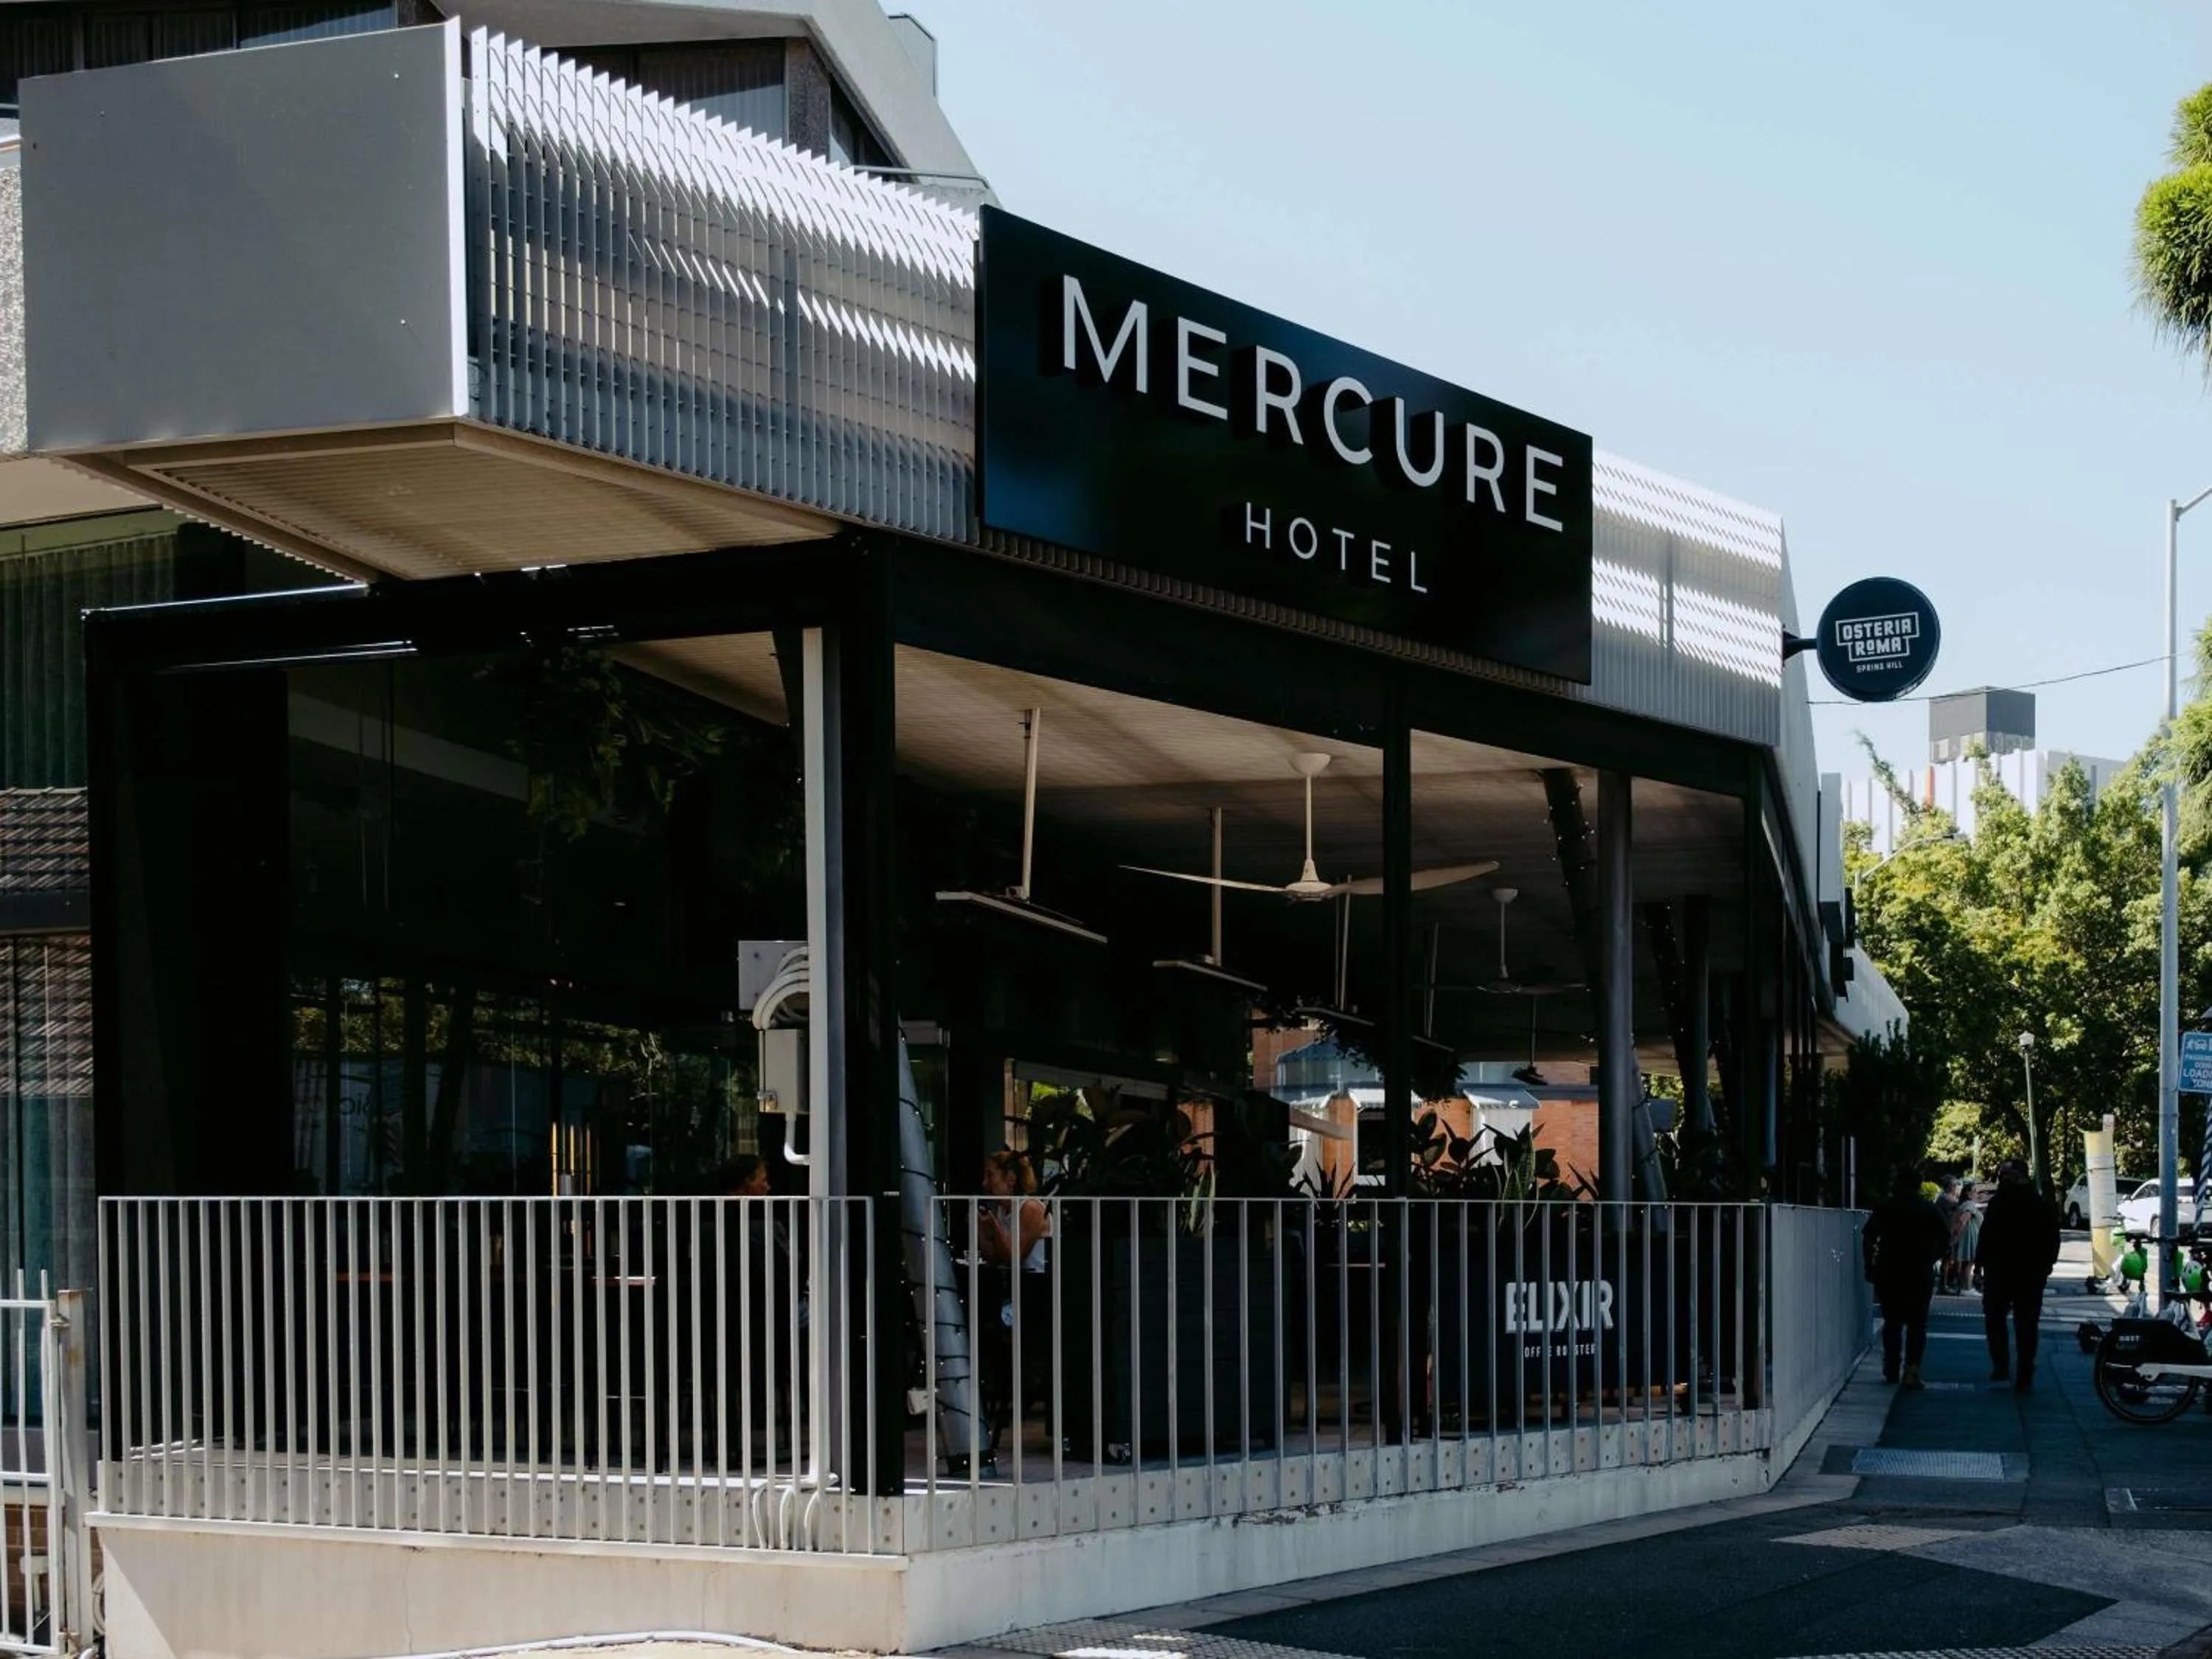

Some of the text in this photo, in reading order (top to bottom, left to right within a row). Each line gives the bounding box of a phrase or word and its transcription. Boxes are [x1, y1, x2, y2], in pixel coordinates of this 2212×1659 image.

[1063, 274, 1564, 532] MERCURE
[1245, 501, 1428, 594] HOTEL
[1843, 618, 1912, 641] OSTERIA
[1855, 636, 1902, 656] ROMA
[2183, 1068, 2212, 1079] LOAD
[1506, 1279, 1613, 1333] ELIXIR
